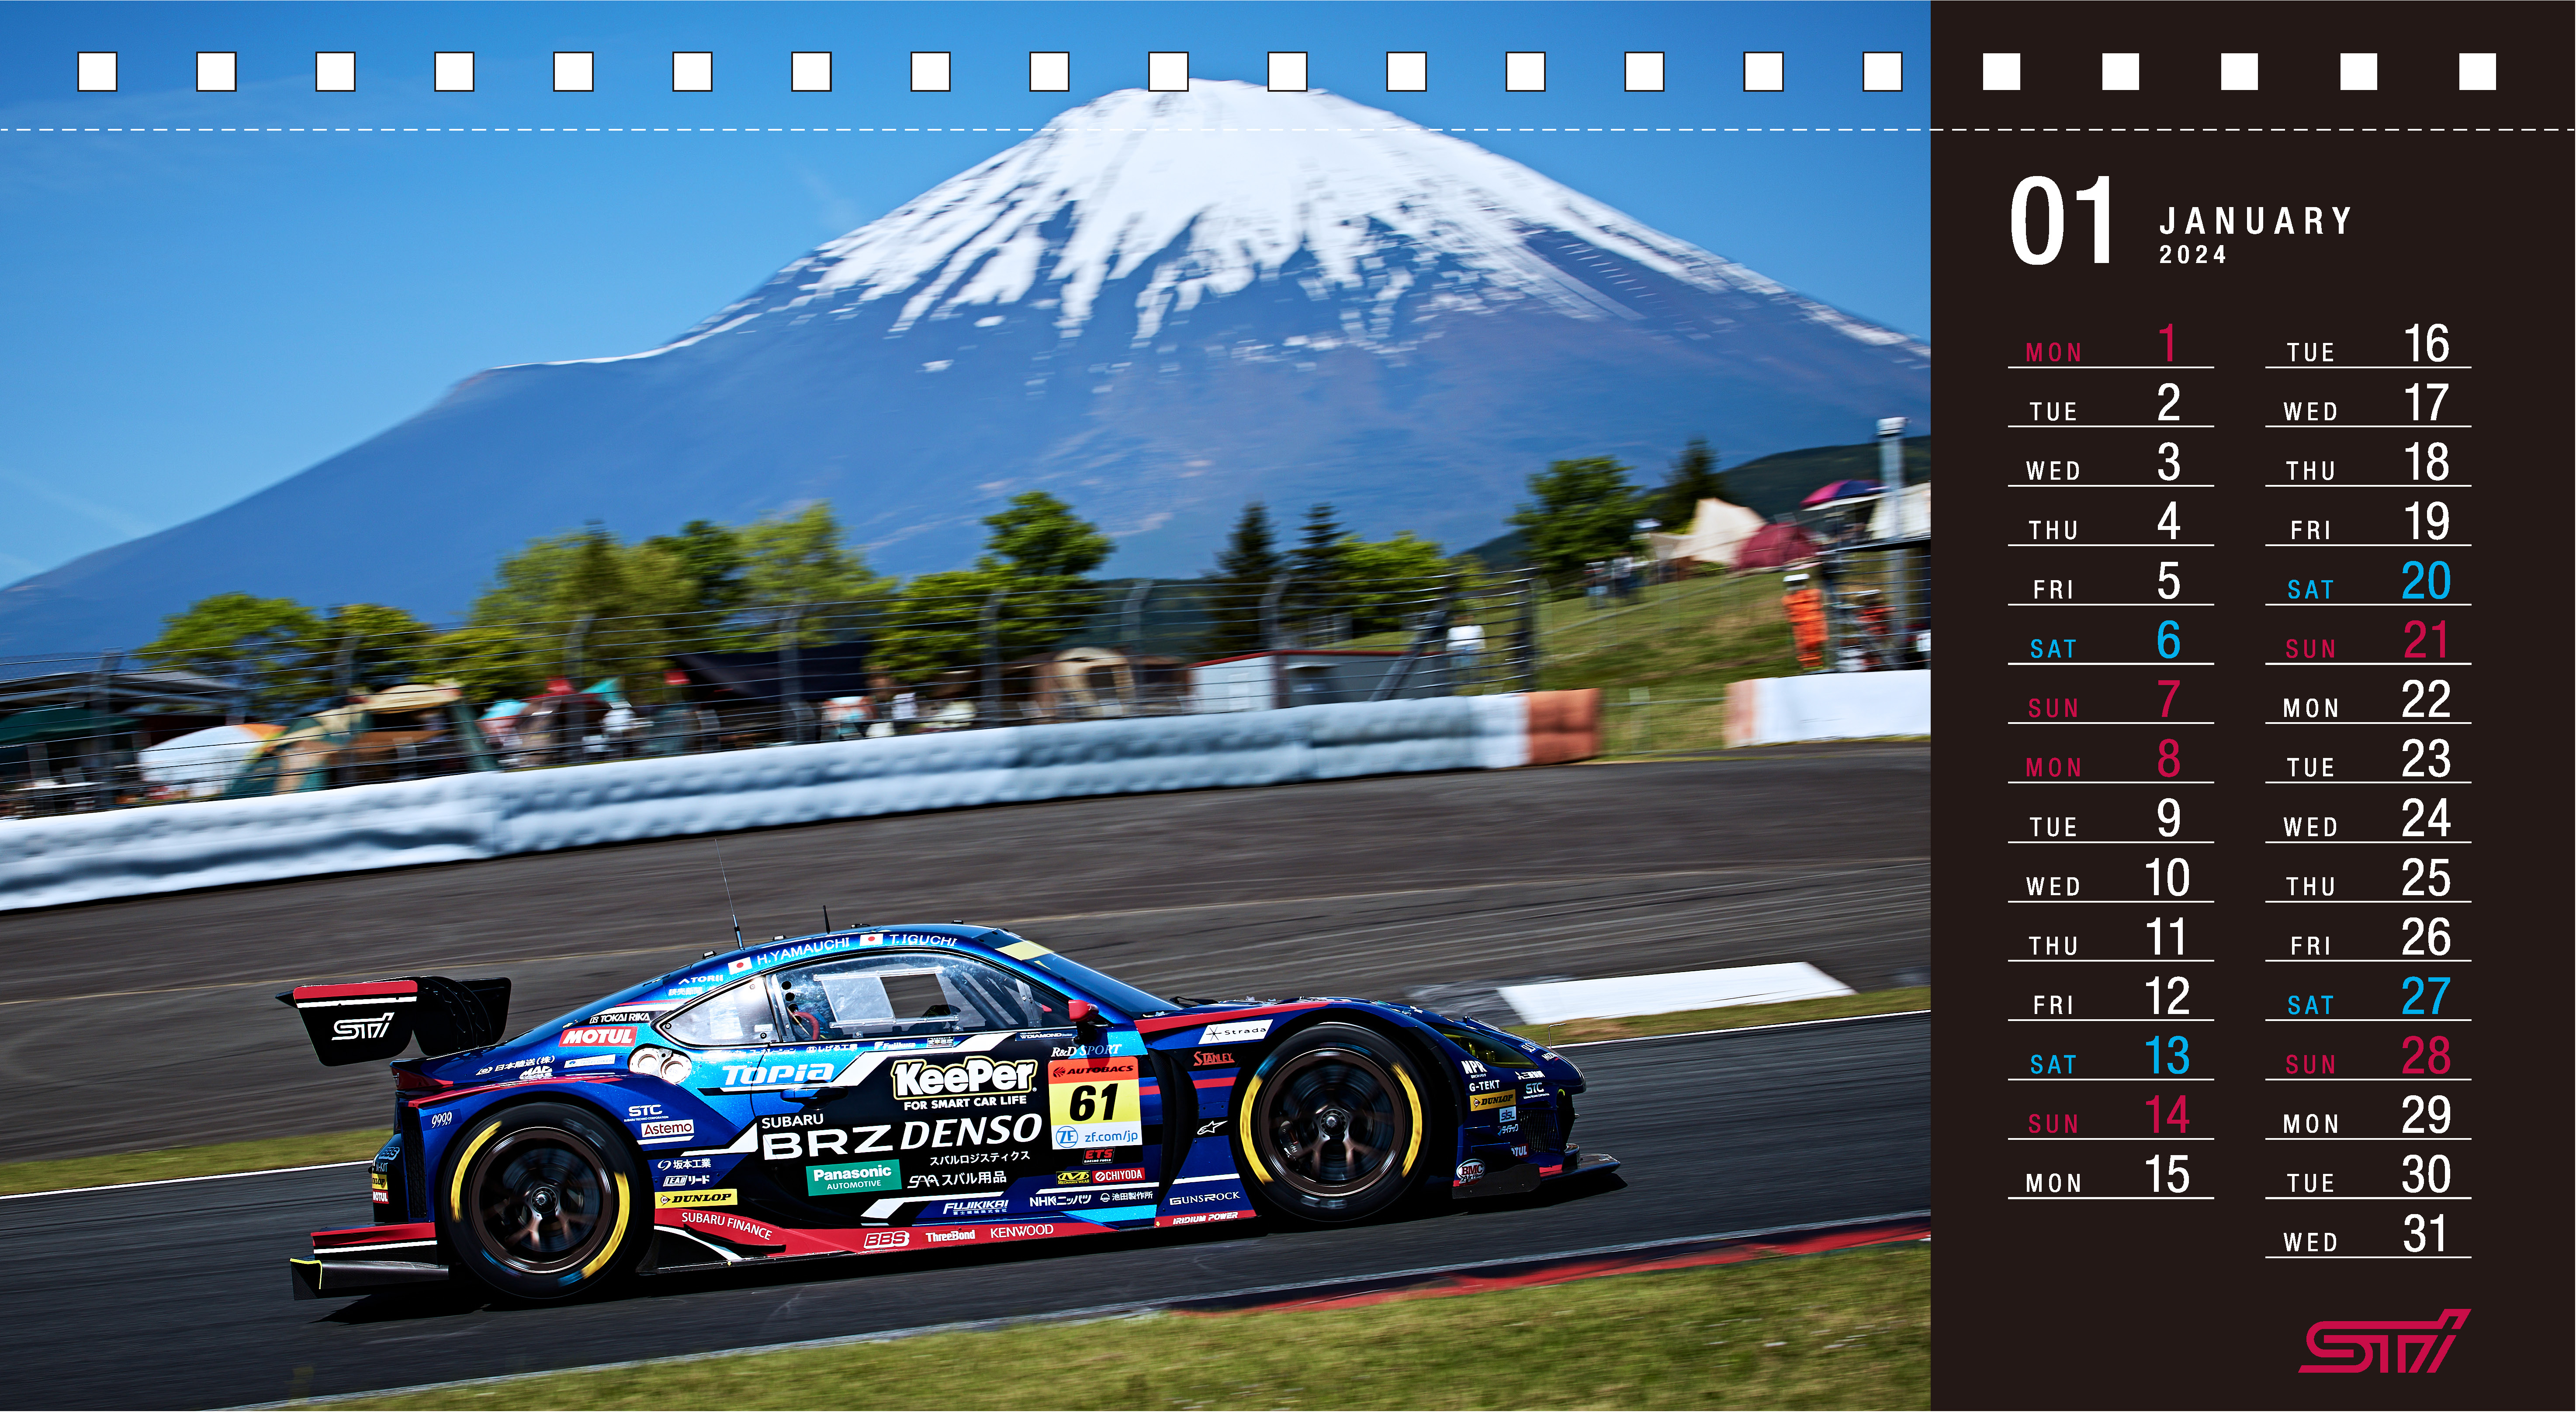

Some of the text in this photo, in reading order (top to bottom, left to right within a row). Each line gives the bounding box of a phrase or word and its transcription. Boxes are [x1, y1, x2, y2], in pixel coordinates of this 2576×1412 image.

[757, 937, 850, 965] H.YAMAUCHI
[601, 1013, 651, 1022] TOKAI RIKA
[564, 1028, 633, 1044] MOTUL
[1051, 1044, 1122, 1057] R&D SPORT
[1193, 1051, 1235, 1066] STANLEY
[1066, 1066, 1133, 1075] AUTOBACS
[1461, 1060, 1488, 1074] NPR
[894, 1059, 1035, 1096] KeePer
[1469, 1080, 1500, 1092] G-TEKT
[1526, 1083, 1544, 1094] STC
[904, 1095, 1027, 1110] FOR SMART CAR LIFE
[1070, 1083, 1118, 1121] 61
[1481, 1094, 1513, 1106] DUNLOP
[629, 1104, 663, 1117] STC
[762, 1114, 824, 1128] SUBARU
[644, 1123, 692, 1135] Astemo
[900, 1114, 1042, 1149] DENSO
[762, 1125, 893, 1160] BRZ
[1057, 1130, 1138, 1144] ZF zf.com/jp
[930, 1151, 1030, 1166] スバルロジスティクス
[1085, 1149, 1113, 1159] ETS
[673, 1158, 711, 1169] 坂本工業
[1461, 1164, 1483, 1176] BMC
[689, 1175, 710, 1185] リード
[814, 1165, 892, 1181] Panasonic
[942, 1170, 1007, 1186] スバル用品
[1106, 1170, 1142, 1180] CHIYODA
[827, 1180, 881, 1191] AUTOMOTIVE
[672, 1194, 732, 1203] DUNLOP
[1112, 1191, 1153, 1201] 池田製作所
[943, 1200, 1009, 1214] FUJIKIKAI
[1173, 1211, 1238, 1225] IRIDIUM POWER
[682, 1212, 773, 1240] SUBARU FINANCE
[990, 1224, 1054, 1238] KENWOOD
[863, 1230, 910, 1249] BBS
[925, 1230, 975, 1242] ThreeBond
